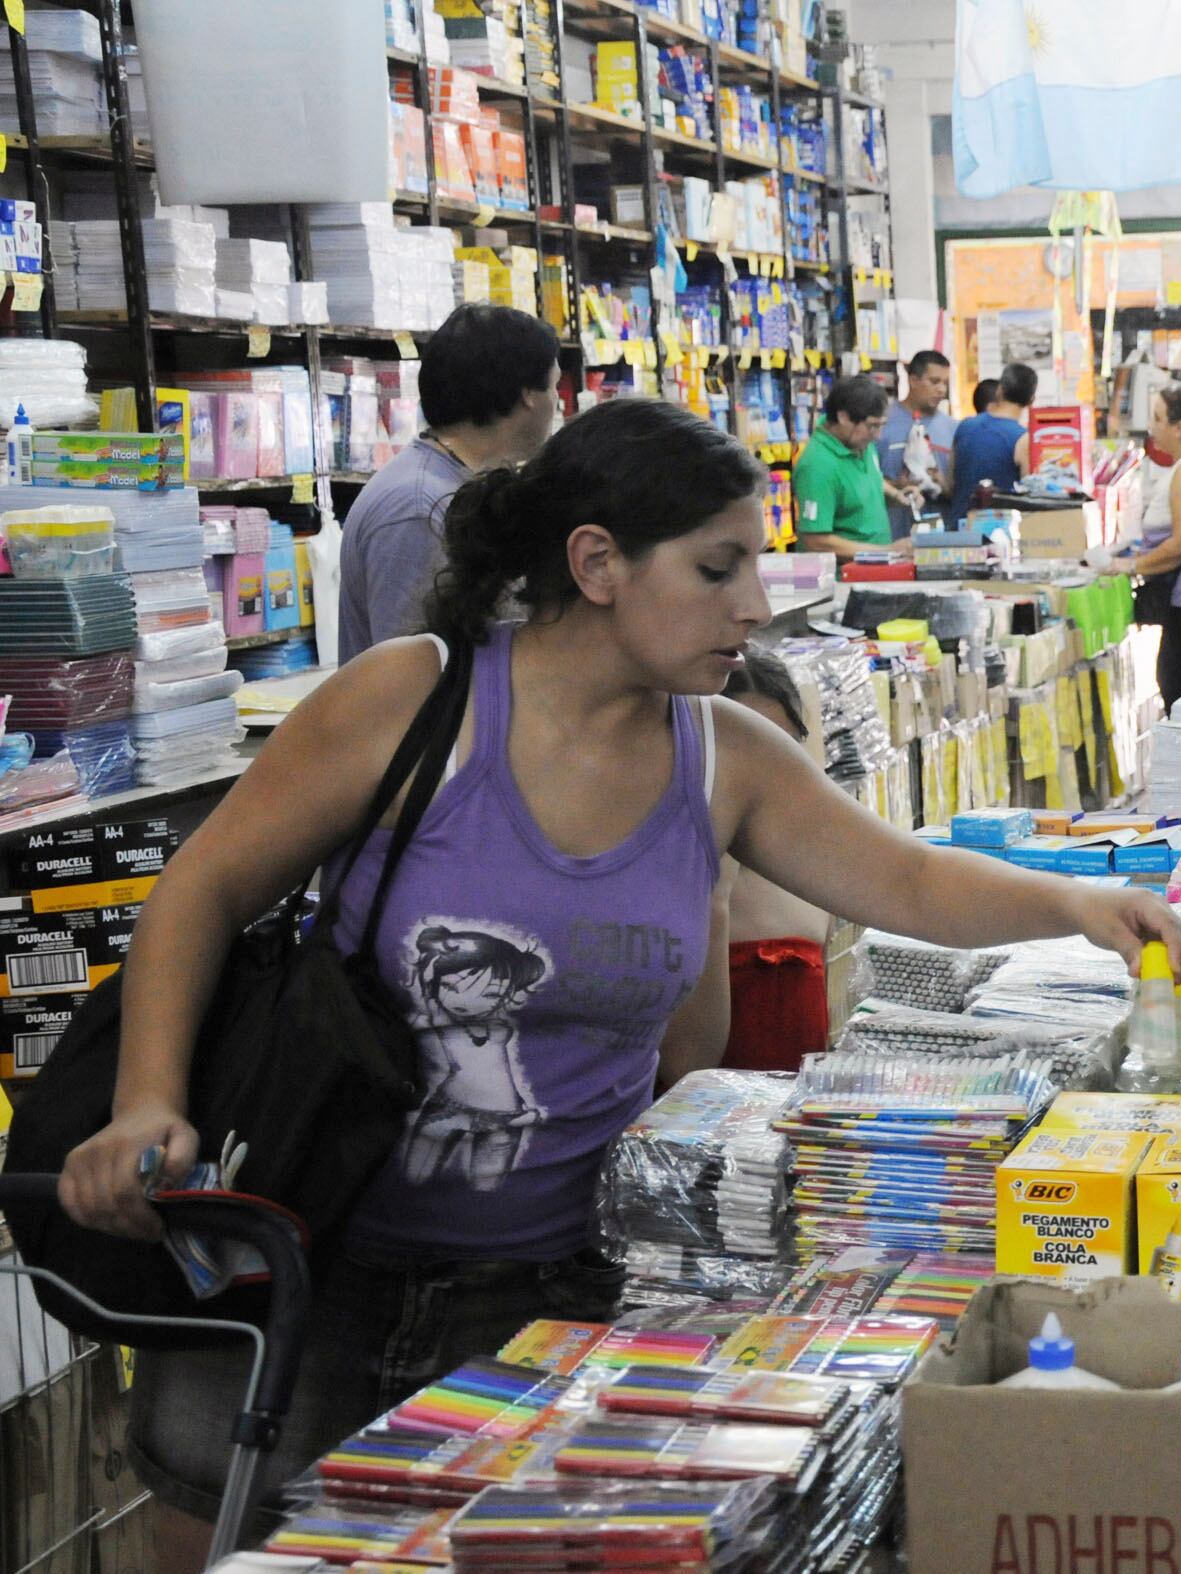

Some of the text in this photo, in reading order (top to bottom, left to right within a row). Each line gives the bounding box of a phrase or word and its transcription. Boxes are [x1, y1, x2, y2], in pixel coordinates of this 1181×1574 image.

[105, 826, 124, 840] AA-4
[29, 834, 54, 849] AA-4
[116, 846, 164, 864] DURACELL
[37, 856, 93, 872] DURACELL
[102, 909, 120, 922] AA-4
[17, 931, 74, 945] DURACELL
[108, 934, 132, 946] DURAC
[25, 1011, 72, 1024] DURACEL
[1022, 1214, 1109, 1228] PEGAMENTO
[1037, 1226, 1094, 1238] BLANCO
[1044, 1242, 1086, 1253] COLA
[1033, 1252, 1098, 1265] BRANCA
